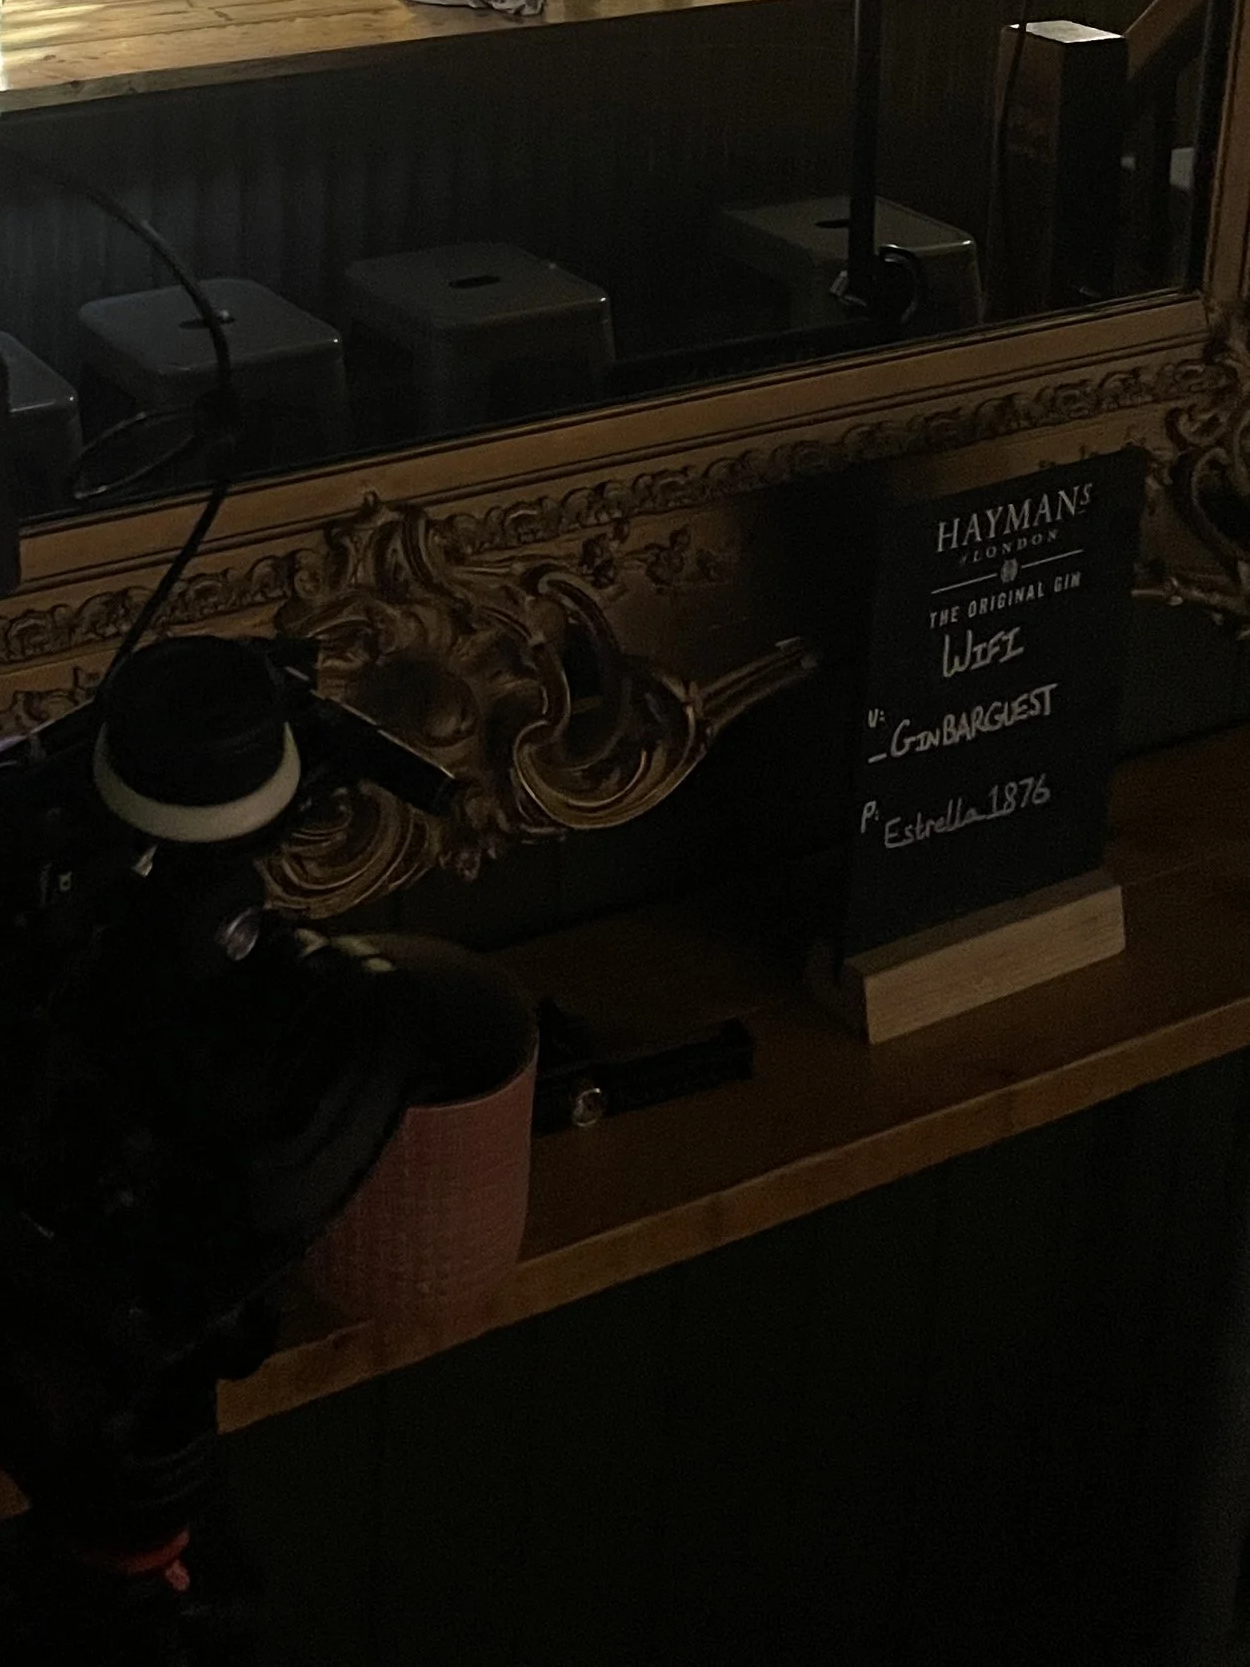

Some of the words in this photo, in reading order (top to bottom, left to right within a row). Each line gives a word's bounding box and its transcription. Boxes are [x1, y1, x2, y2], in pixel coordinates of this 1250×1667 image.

[972, 528, 1060, 563] LONDON
[928, 605, 960, 630] THE
[967, 581, 1046, 619] ORIGINAL
[1053, 570, 1082, 594] GIN
